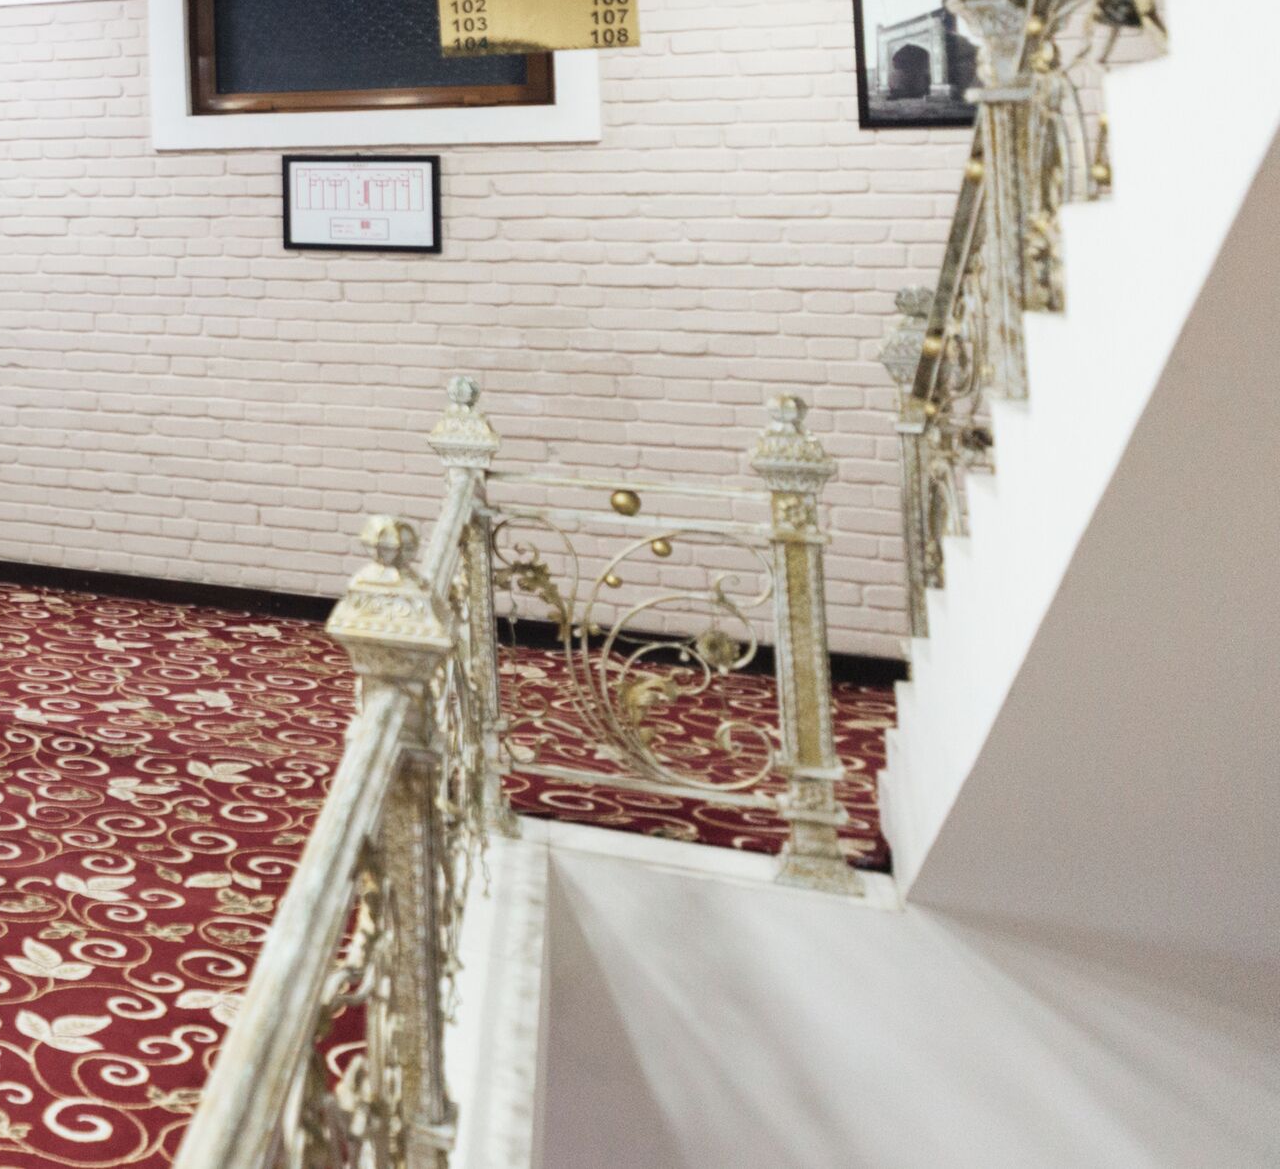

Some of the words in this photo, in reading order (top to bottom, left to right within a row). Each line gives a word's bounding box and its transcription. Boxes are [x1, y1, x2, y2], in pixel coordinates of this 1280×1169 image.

[452, 16, 488, 32] 103
[591, 8, 630, 25] 107
[454, 36, 488, 51] 104
[591, 27, 630, 44] 108
